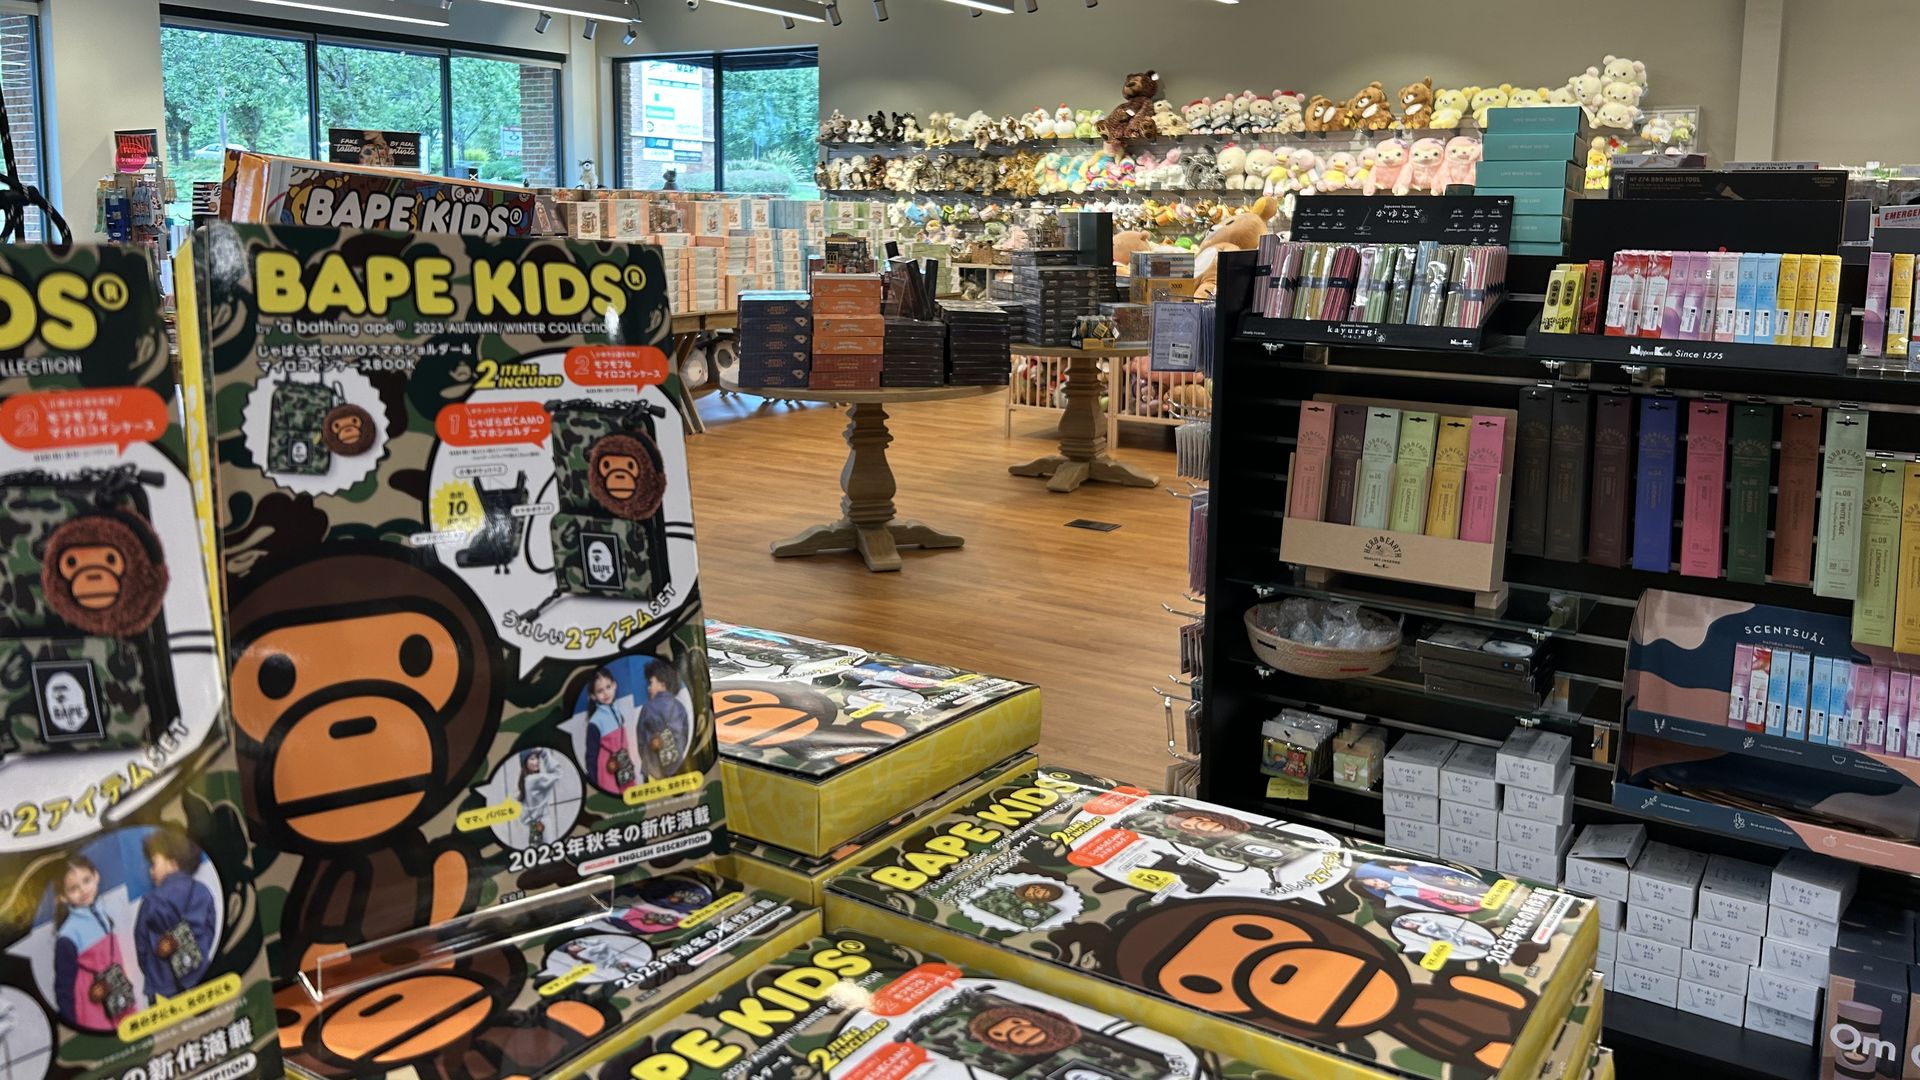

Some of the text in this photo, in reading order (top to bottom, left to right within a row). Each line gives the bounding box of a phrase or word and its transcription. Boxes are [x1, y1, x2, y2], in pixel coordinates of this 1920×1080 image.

[305, 187, 417, 231] BAPE
[1375, 209, 1423, 219] かゆらぎ
[255, 252, 455, 315] BAPE
[296, 319, 359, 336] bathing
[414, 322, 444, 334] 2023
[549, 322, 616, 336] COLLECTIO
[1327, 325, 1378, 337] kayuragi
[1674, 349, 1700, 359] Since
[1702, 351, 1724, 361] 1575
[473, 359, 499, 389] 2
[499, 363, 539, 376] ITEMS
[498, 376, 564, 388] INCLUDED
[1826, 450, 1840, 464] HERB
[1846, 450, 1864, 466] EARTH
[1363, 537, 1379, 554] HERB
[1385, 537, 1402, 558] EARTH
[508, 804, 711, 873] 2023年秋冬の新作満載
[871, 821, 1001, 892] BAPE
[1830, 1023, 1896, 1061] Om
[807, 1048, 840, 1074] 2
